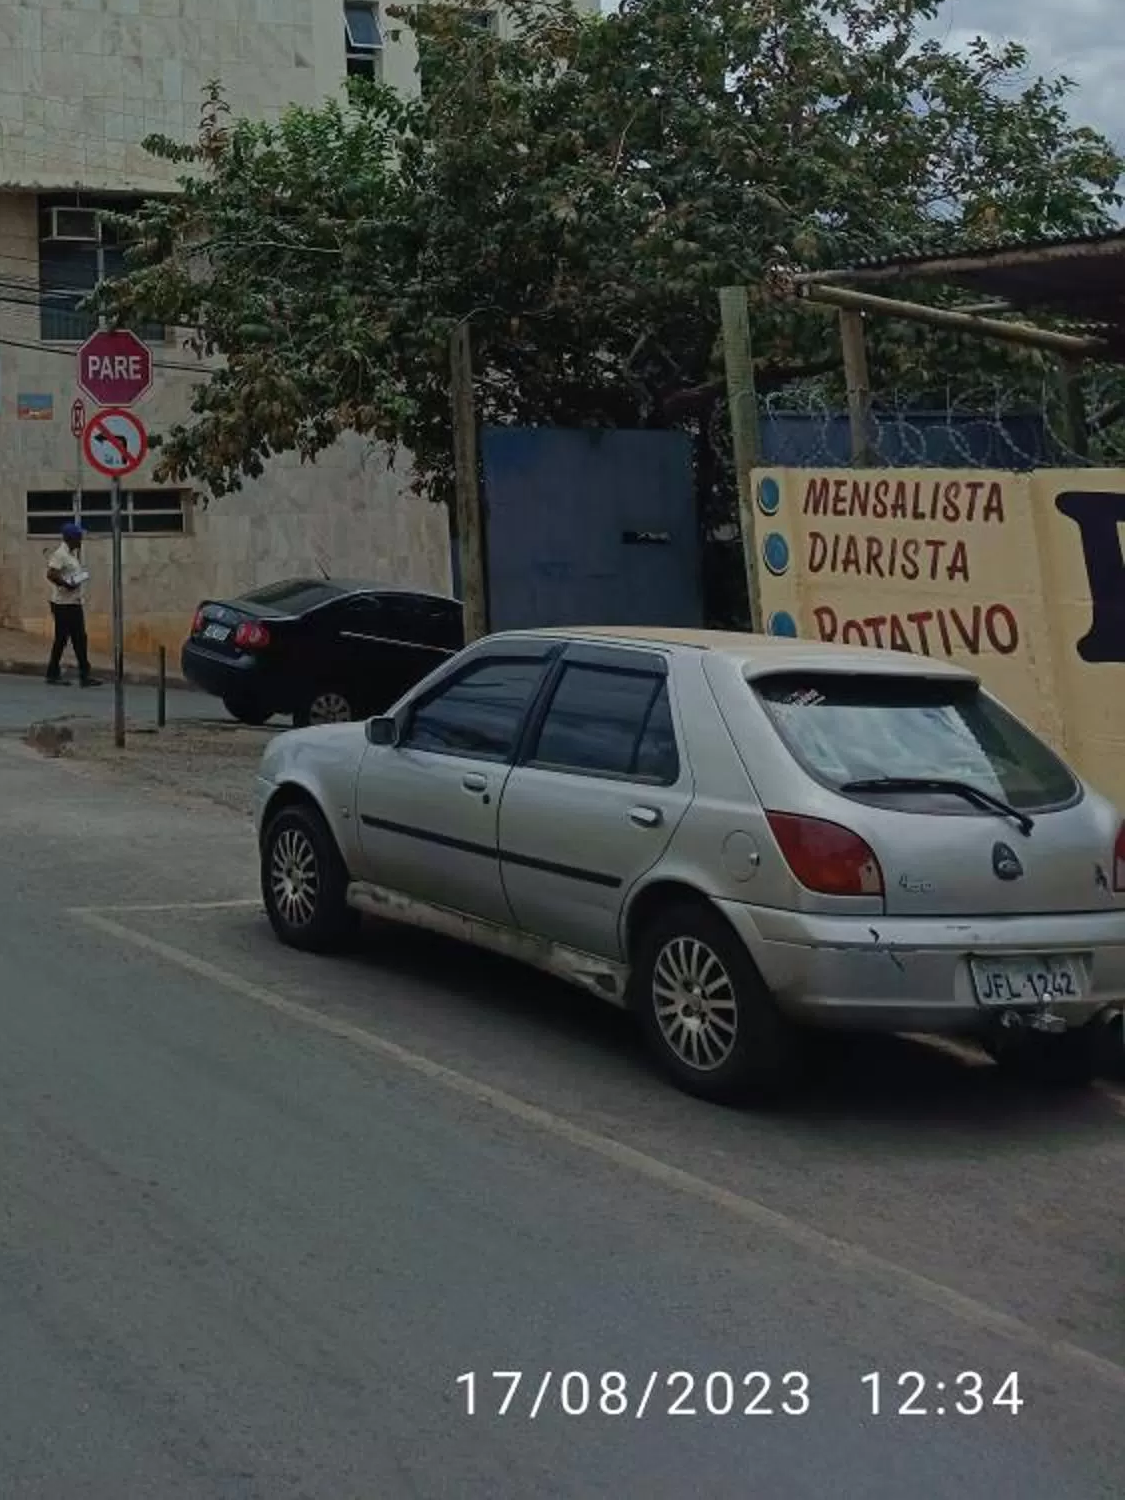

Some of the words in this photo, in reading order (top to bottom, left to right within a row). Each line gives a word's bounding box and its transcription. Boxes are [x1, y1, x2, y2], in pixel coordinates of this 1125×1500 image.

[88, 355, 142, 380] PARE
[803, 478, 1004, 523] MENSALISTA
[808, 531, 969, 582] DIARISTA
